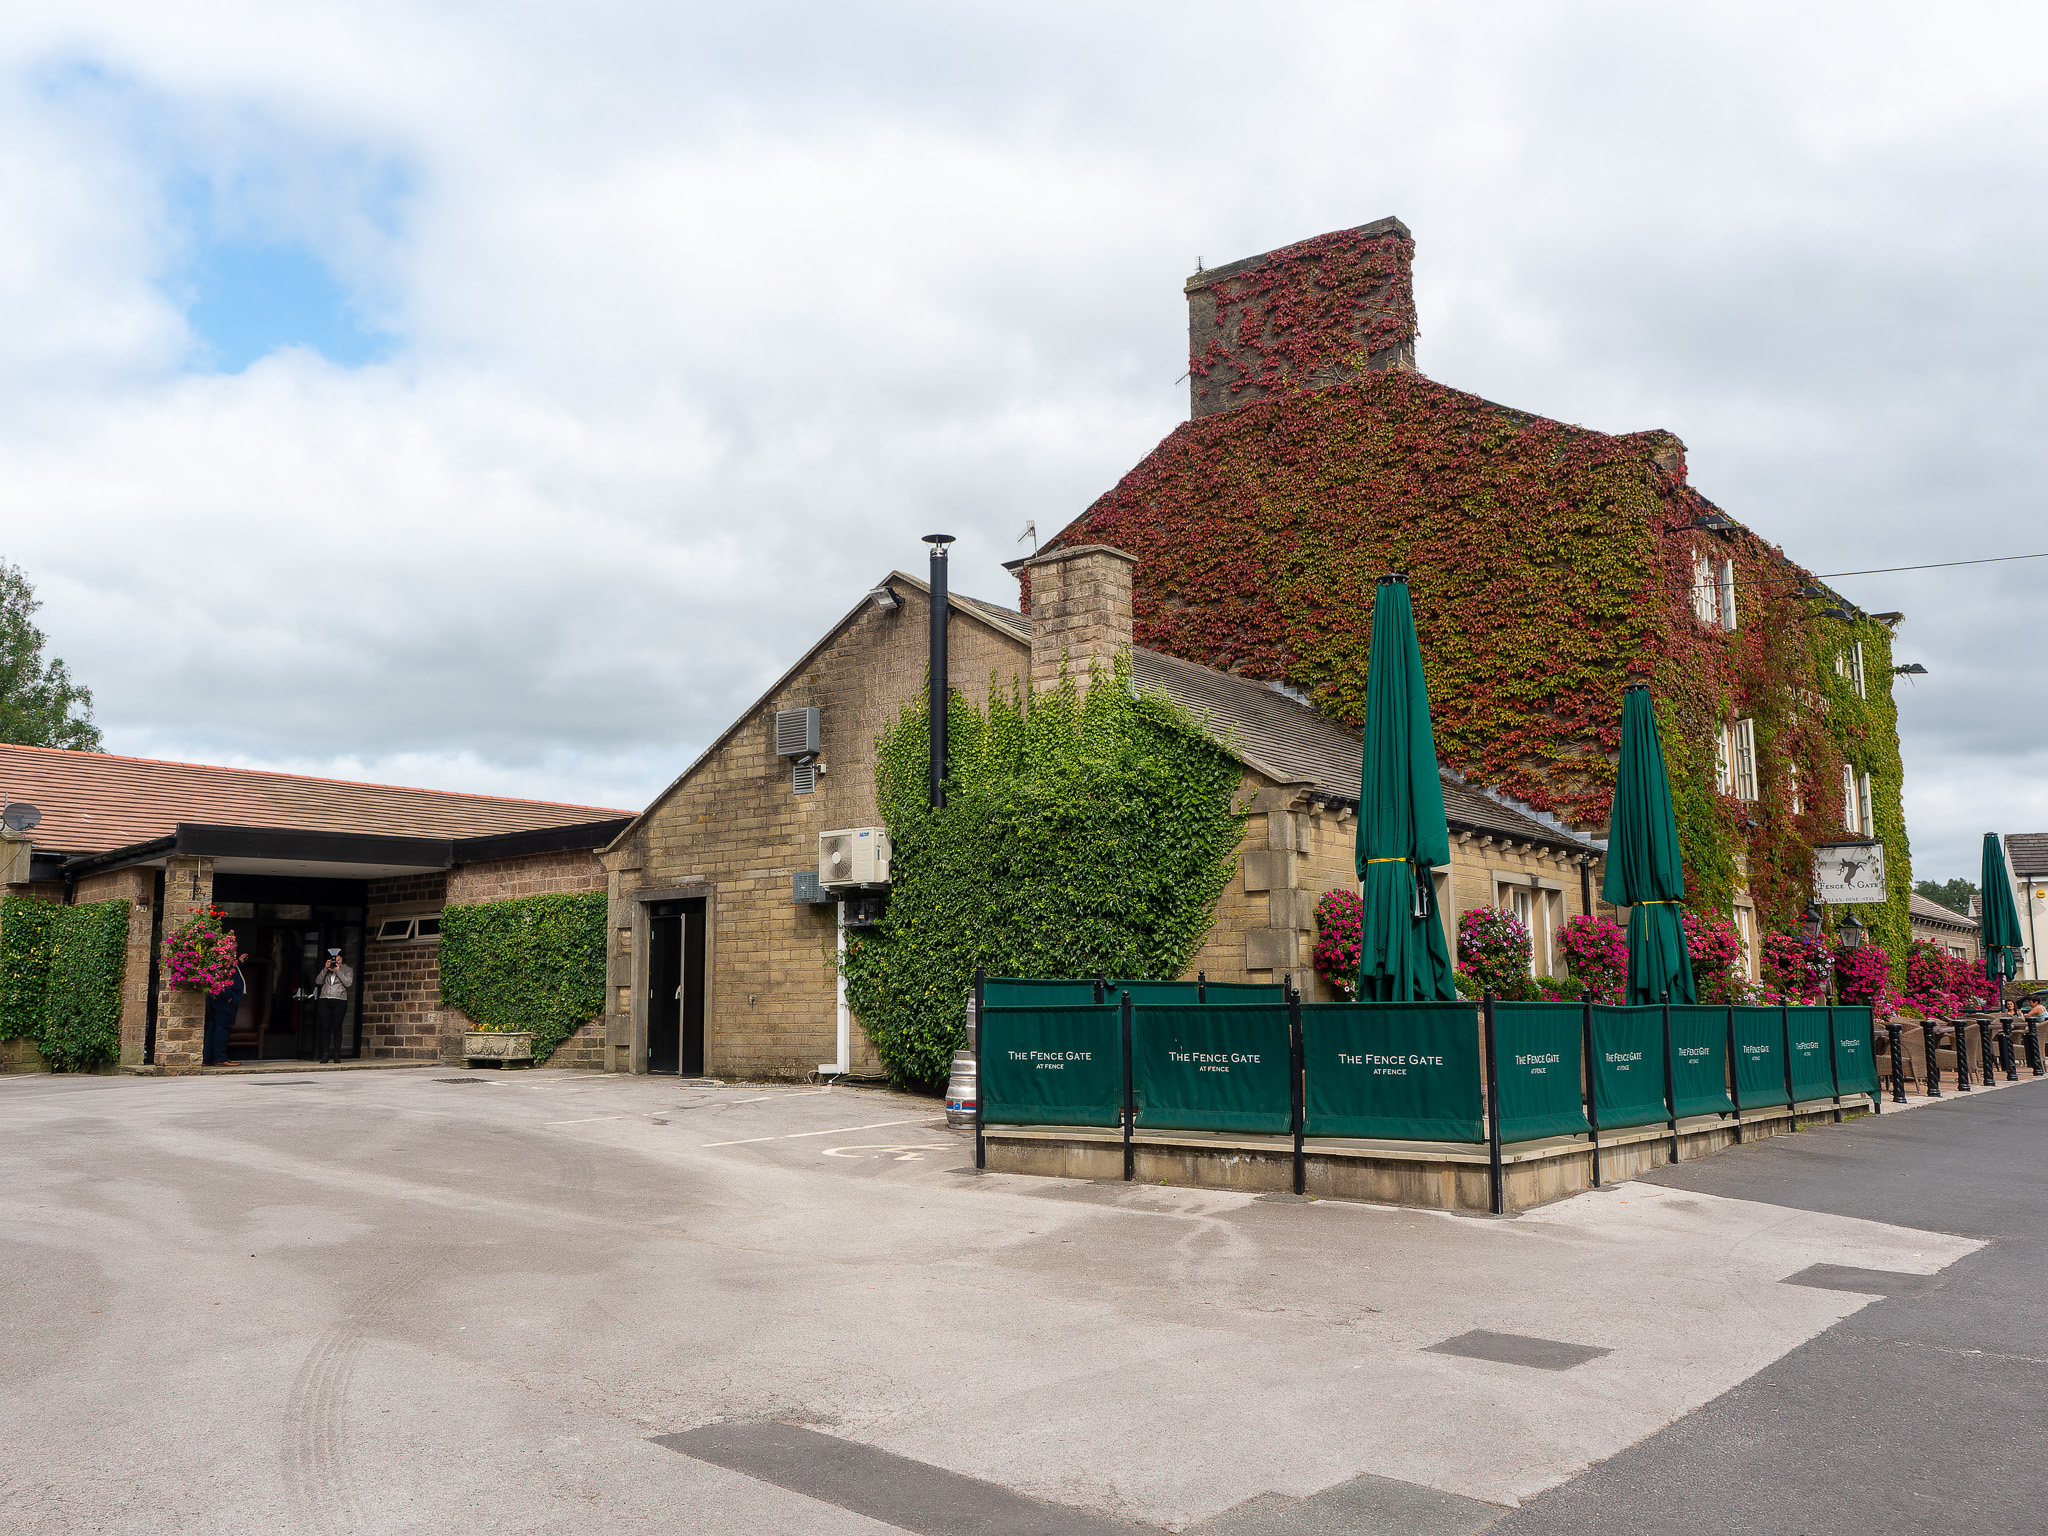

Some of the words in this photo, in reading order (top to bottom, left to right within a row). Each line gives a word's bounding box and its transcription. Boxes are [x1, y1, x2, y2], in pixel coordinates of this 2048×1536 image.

[1856, 881, 1879, 889] GATE
[1007, 1050, 1028, 1060] THE
[1030, 1050, 1064, 1060] FENCE
[1065, 1051, 1092, 1061] GATE
[1168, 1051, 1191, 1062] THE
[1192, 1052, 1229, 1063] FENCE
[1230, 1053, 1261, 1064] GATE
[1338, 1053, 1363, 1064] THE
[1365, 1053, 1406, 1065] FENCE
[1408, 1054, 1443, 1066] GATE
[1515, 1054, 1526, 1065] THE
[1526, 1054, 1545, 1065] FENCE
[1545, 1053, 1560, 1063] GATE
